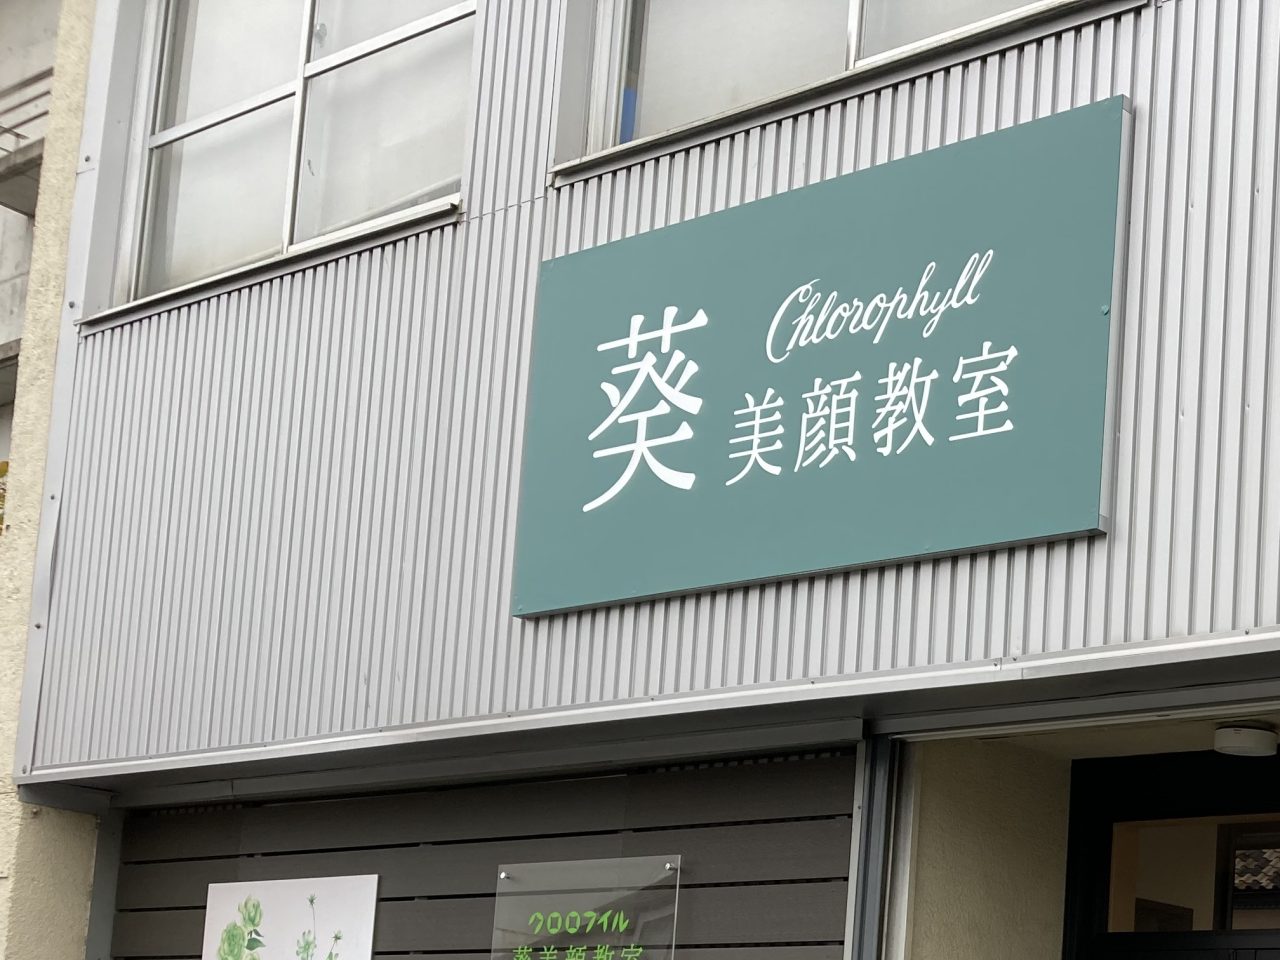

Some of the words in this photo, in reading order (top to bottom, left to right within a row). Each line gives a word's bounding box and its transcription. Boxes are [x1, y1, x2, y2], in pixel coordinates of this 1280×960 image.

[765, 249, 994, 364] Chlorophyll
[582, 306, 709, 513] 葵
[725, 341, 1019, 487] 美顔教室
